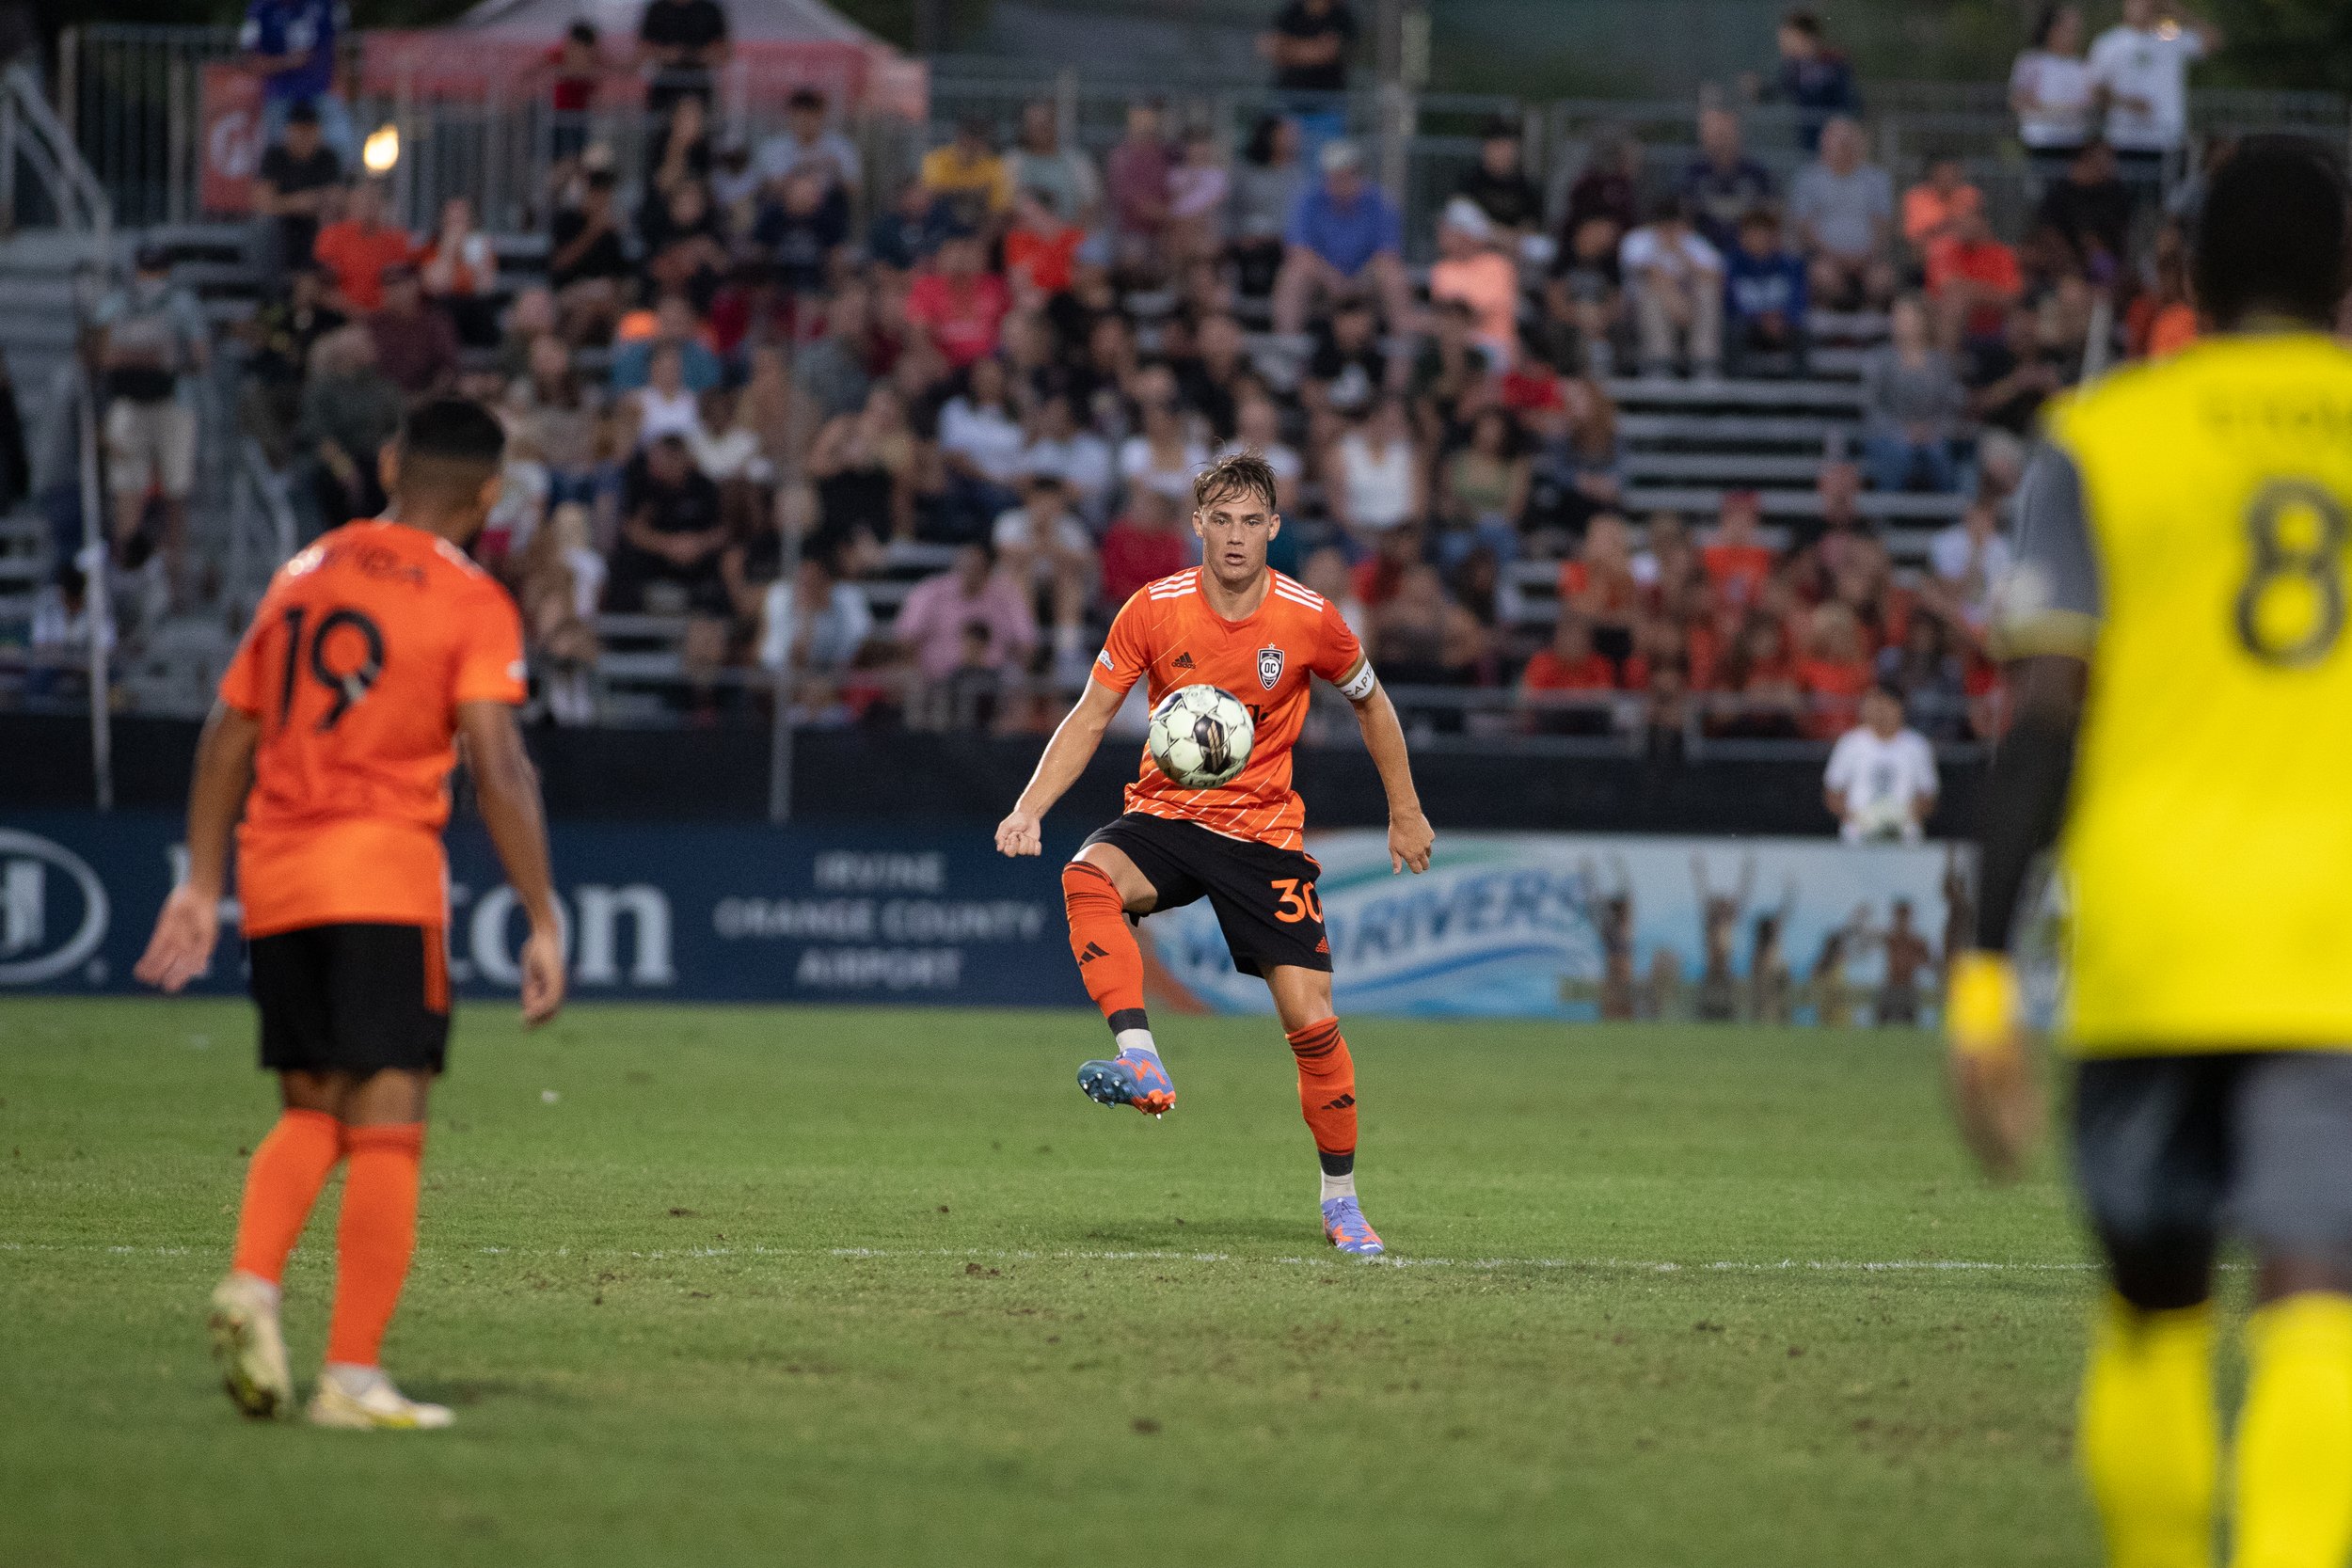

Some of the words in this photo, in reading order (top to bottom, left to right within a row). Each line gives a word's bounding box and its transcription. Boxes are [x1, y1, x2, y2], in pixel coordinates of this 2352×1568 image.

[2233, 473, 2350, 673] 8
[279, 604, 385, 735] 19
[1264, 662, 1276, 673] OC
[713, 897, 873, 941] ORANGE
[881, 899, 1044, 942] COUNTY
[1271, 879, 1325, 924] 30
[798, 947, 961, 989] AIRPORT
